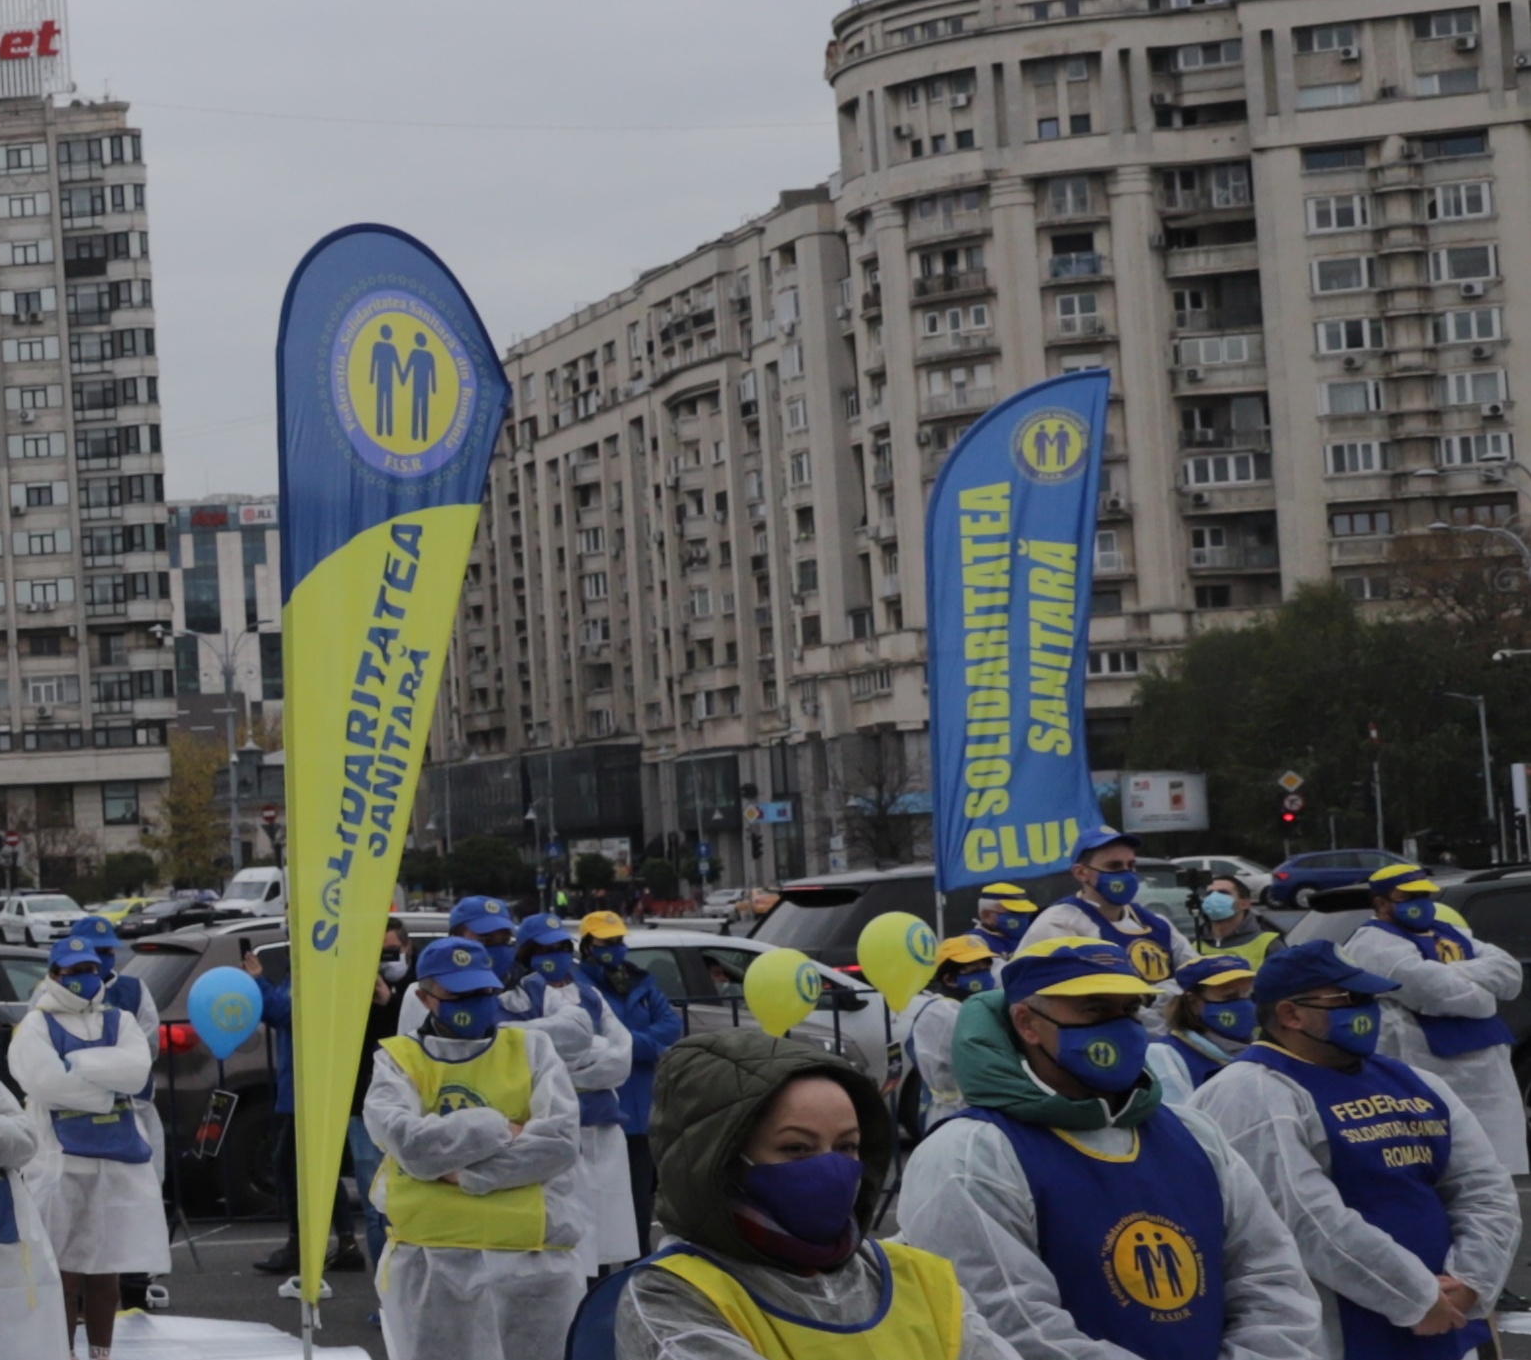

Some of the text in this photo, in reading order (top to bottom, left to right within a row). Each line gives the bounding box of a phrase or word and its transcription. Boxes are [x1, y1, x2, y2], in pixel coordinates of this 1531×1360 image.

[456, 355, 470, 381] din
[367, 644, 431, 858] SANITARĂ
[959, 481, 1012, 821] SOLIDARITATEA
[1017, 537, 1078, 757] SANITARĂ
